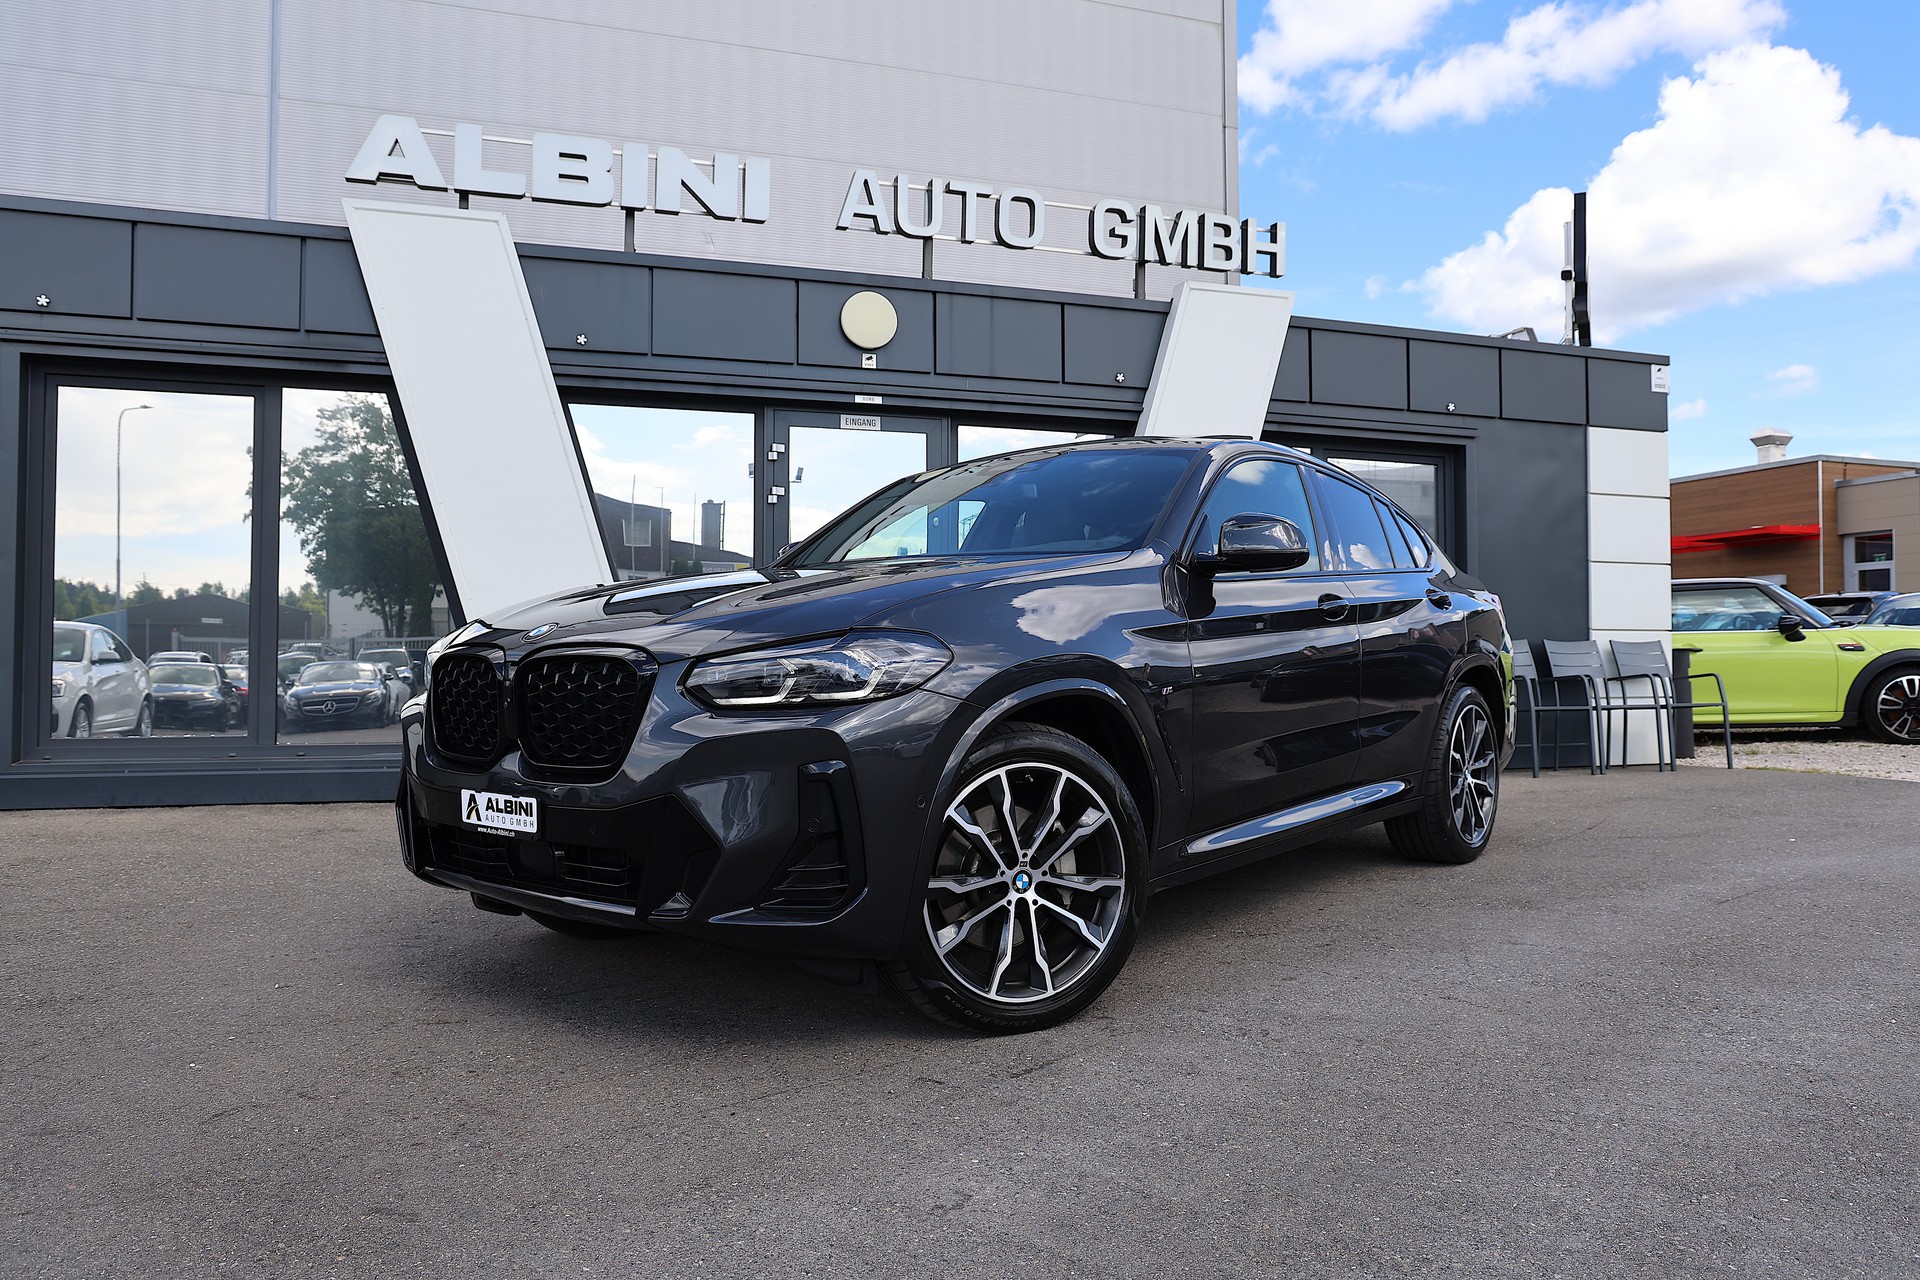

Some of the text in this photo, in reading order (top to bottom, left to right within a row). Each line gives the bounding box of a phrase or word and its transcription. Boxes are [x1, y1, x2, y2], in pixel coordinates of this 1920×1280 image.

[344, 114, 1287, 279] ALBINI AUTO GMBH
[845, 417, 877, 427] EINGANG
[485, 797, 533, 817] ALBINI
[485, 814, 534, 828] AUTO GMBH
